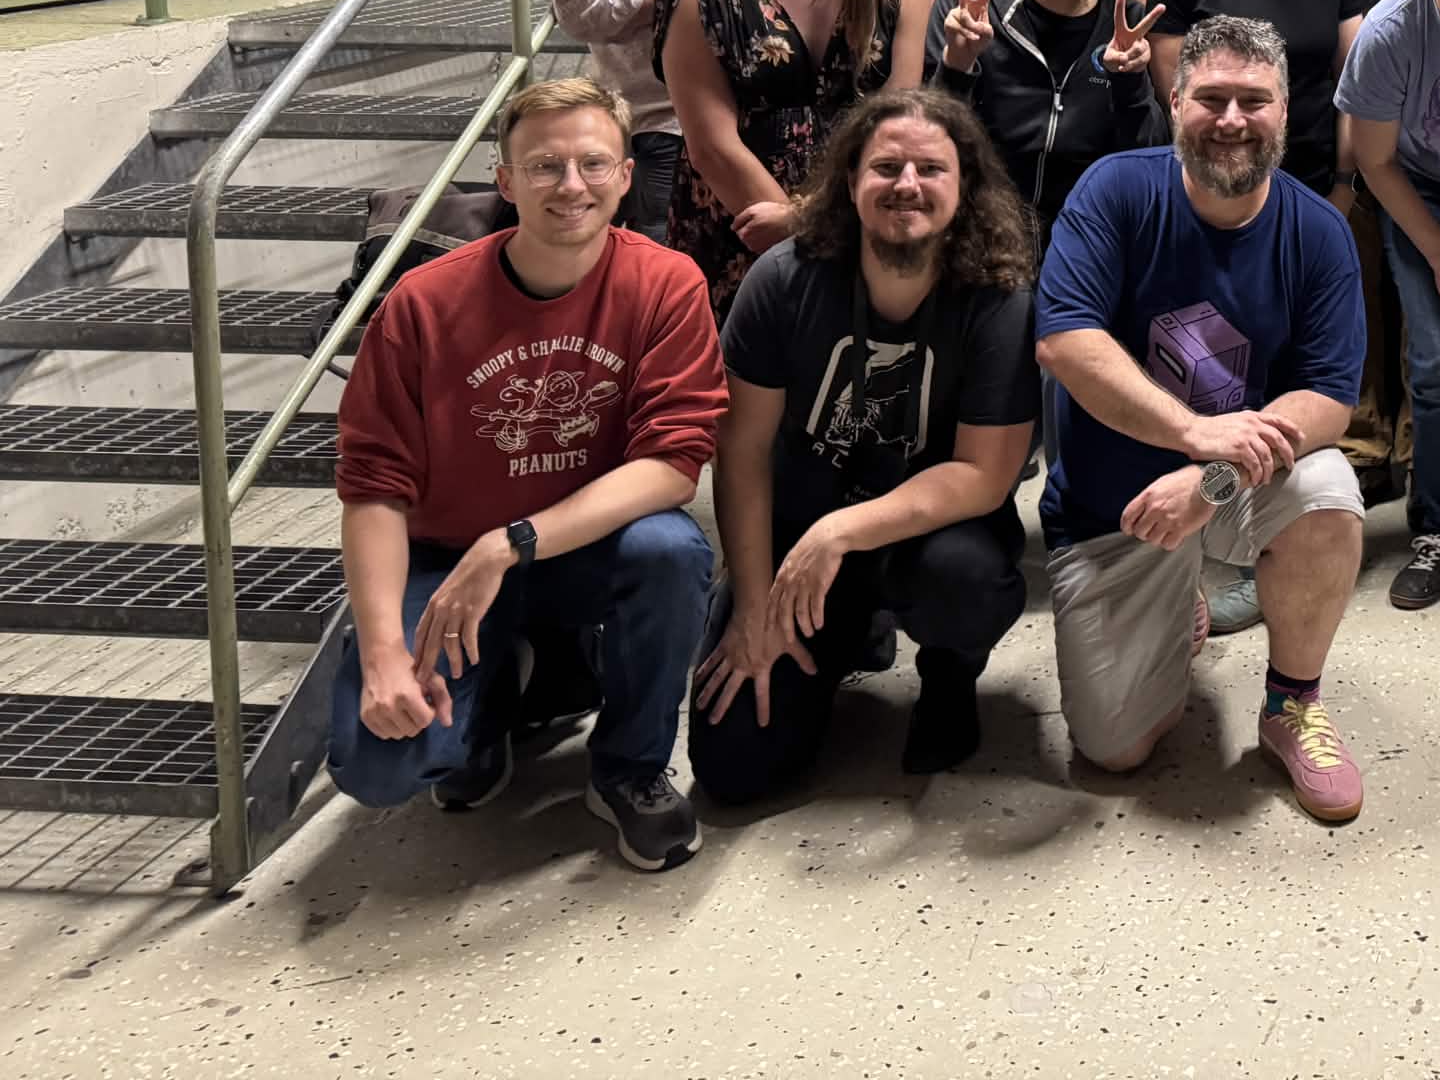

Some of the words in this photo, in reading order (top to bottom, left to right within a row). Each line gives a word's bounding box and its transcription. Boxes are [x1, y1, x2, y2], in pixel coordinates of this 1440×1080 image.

[466, 350, 514, 389] SNOOPY
[518, 346, 528, 362] &
[508, 448, 588, 478] PEANUTS
